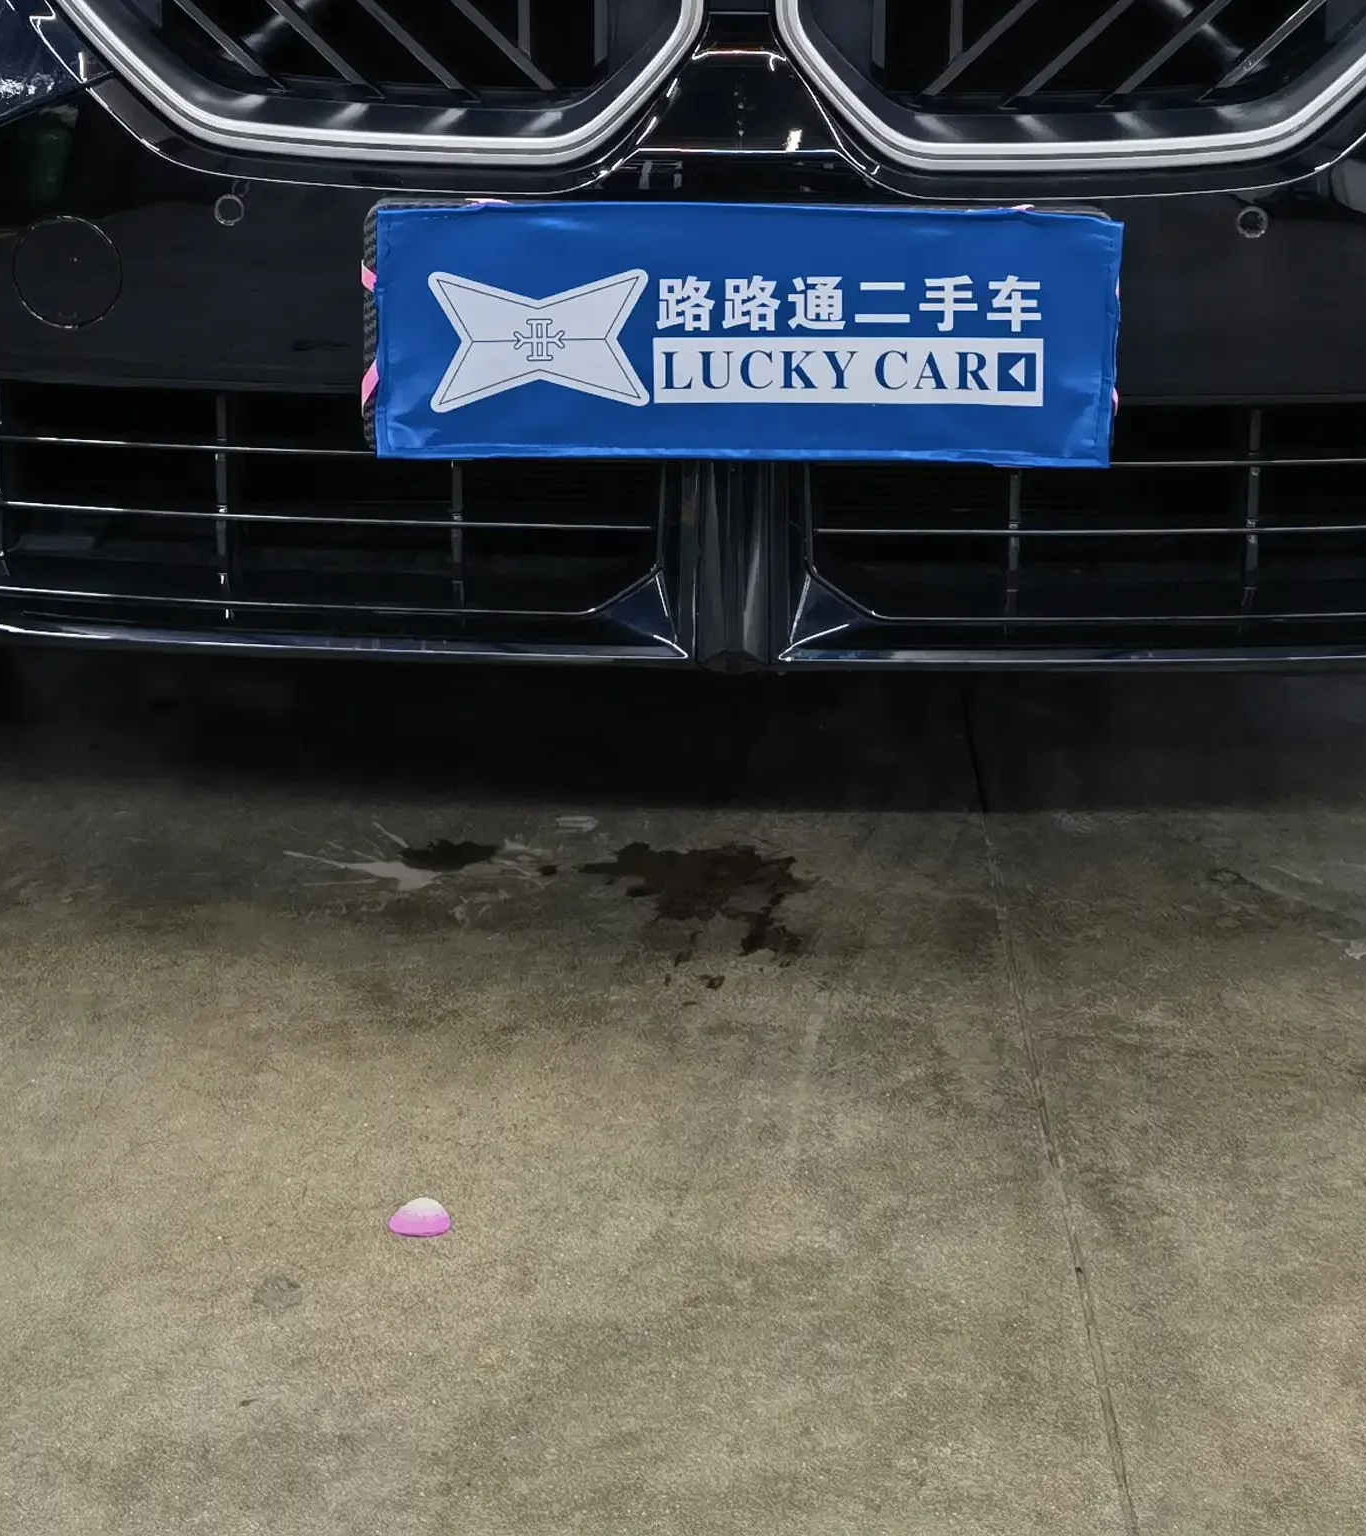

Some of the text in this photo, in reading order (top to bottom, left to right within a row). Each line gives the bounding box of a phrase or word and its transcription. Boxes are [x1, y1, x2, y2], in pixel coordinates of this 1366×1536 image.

[656, 275, 1042, 332] 路路通二手车
[661, 349, 991, 392] LUCKY CAR
